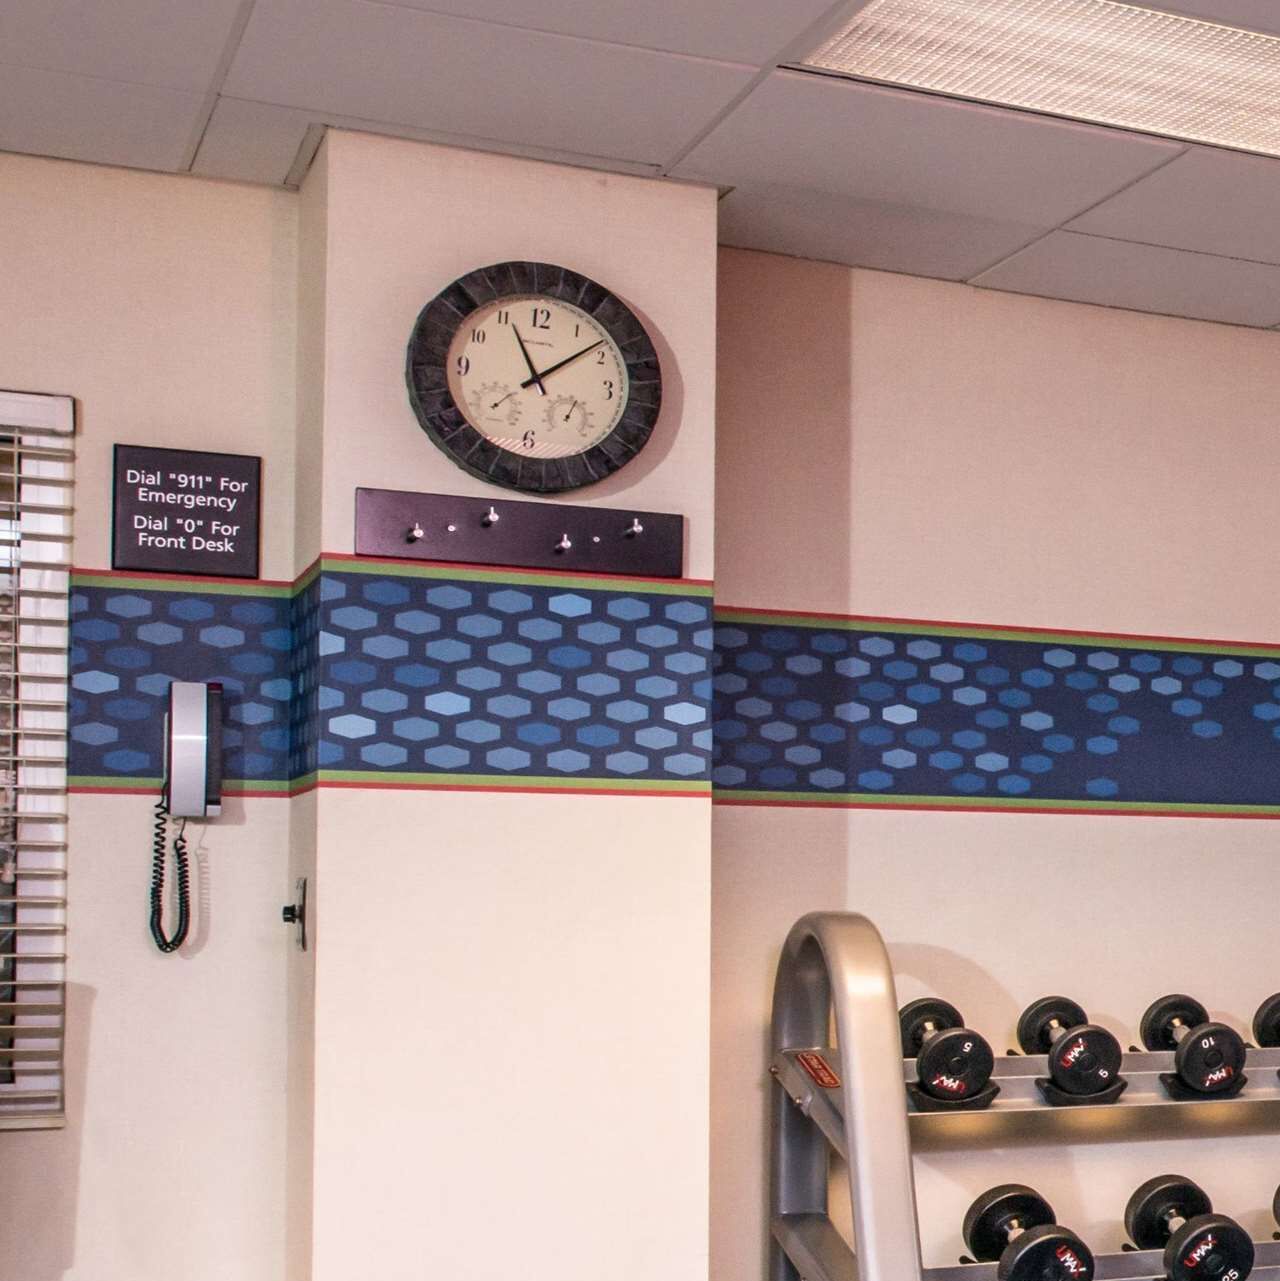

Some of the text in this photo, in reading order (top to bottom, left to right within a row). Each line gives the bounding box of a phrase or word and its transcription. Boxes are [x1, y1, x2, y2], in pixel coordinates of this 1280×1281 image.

[497, 310, 509, 325] 11
[531, 308, 551, 330] 12
[471, 329, 486, 344] 10
[574, 324, 580, 338] 1
[457, 355, 470, 377] 9
[596, 351, 606, 365] 2
[602, 380, 613, 401] 3
[522, 430, 536, 450] 6
[126, 469, 249, 493] Dial "911" For
[138, 487, 237, 512] Emergency
[133, 515, 241, 536] Dial "0" For
[138, 532, 235, 553] Front Desk
[962, 1042, 973, 1053] 5
[1201, 1036, 1215, 1049] 10
[1098, 1068, 1109, 1079] 5
[1055, 1244, 1087, 1279] UMAX
[1183, 1233, 1217, 1269] UMAX
